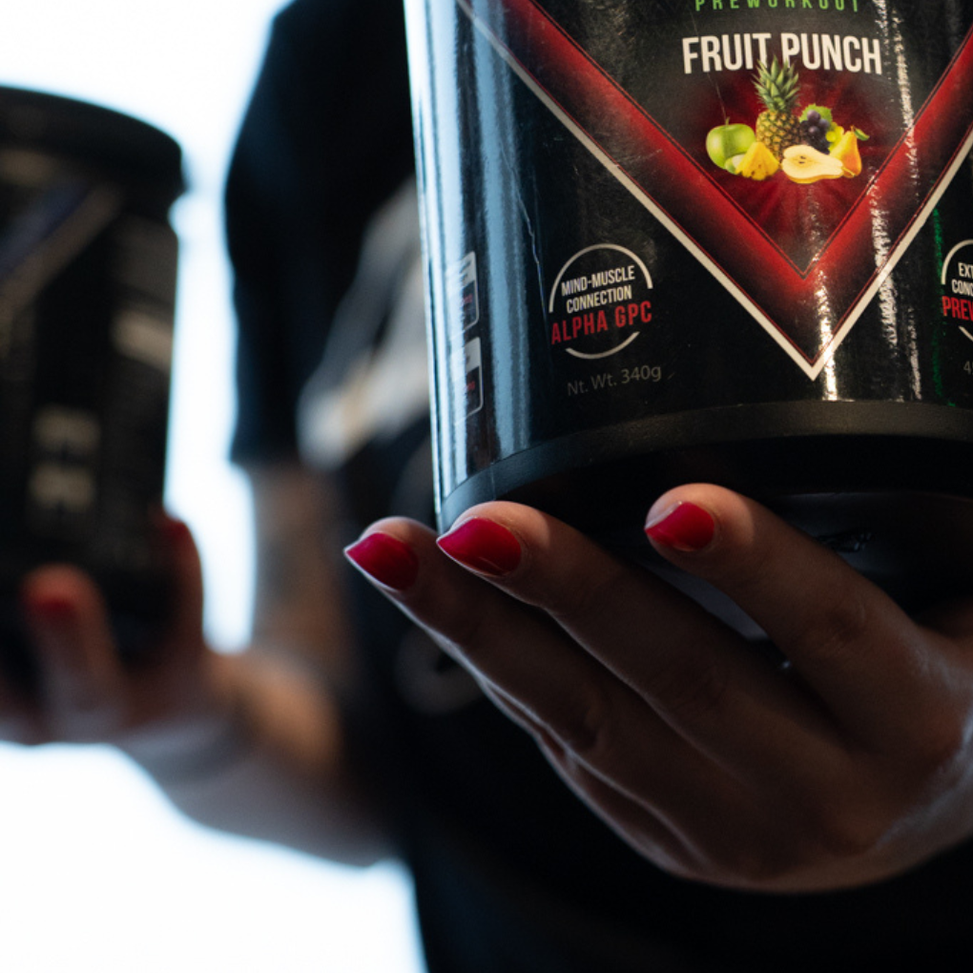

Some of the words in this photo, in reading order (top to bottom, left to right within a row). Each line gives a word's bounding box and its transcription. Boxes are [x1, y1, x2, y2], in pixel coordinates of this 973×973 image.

[682, 32, 772, 74] FRUIT
[781, 32, 882, 75] PUNCH
[561, 265, 636, 297] MIND-MUSCLE
[566, 285, 632, 314] CONNECTION
[551, 310, 608, 345] ALPHA
[615, 300, 652, 328] GPC
[567, 380, 589, 396] Nt.
[591, 372, 617, 390] Wt.
[620, 365, 662, 384] 340g
